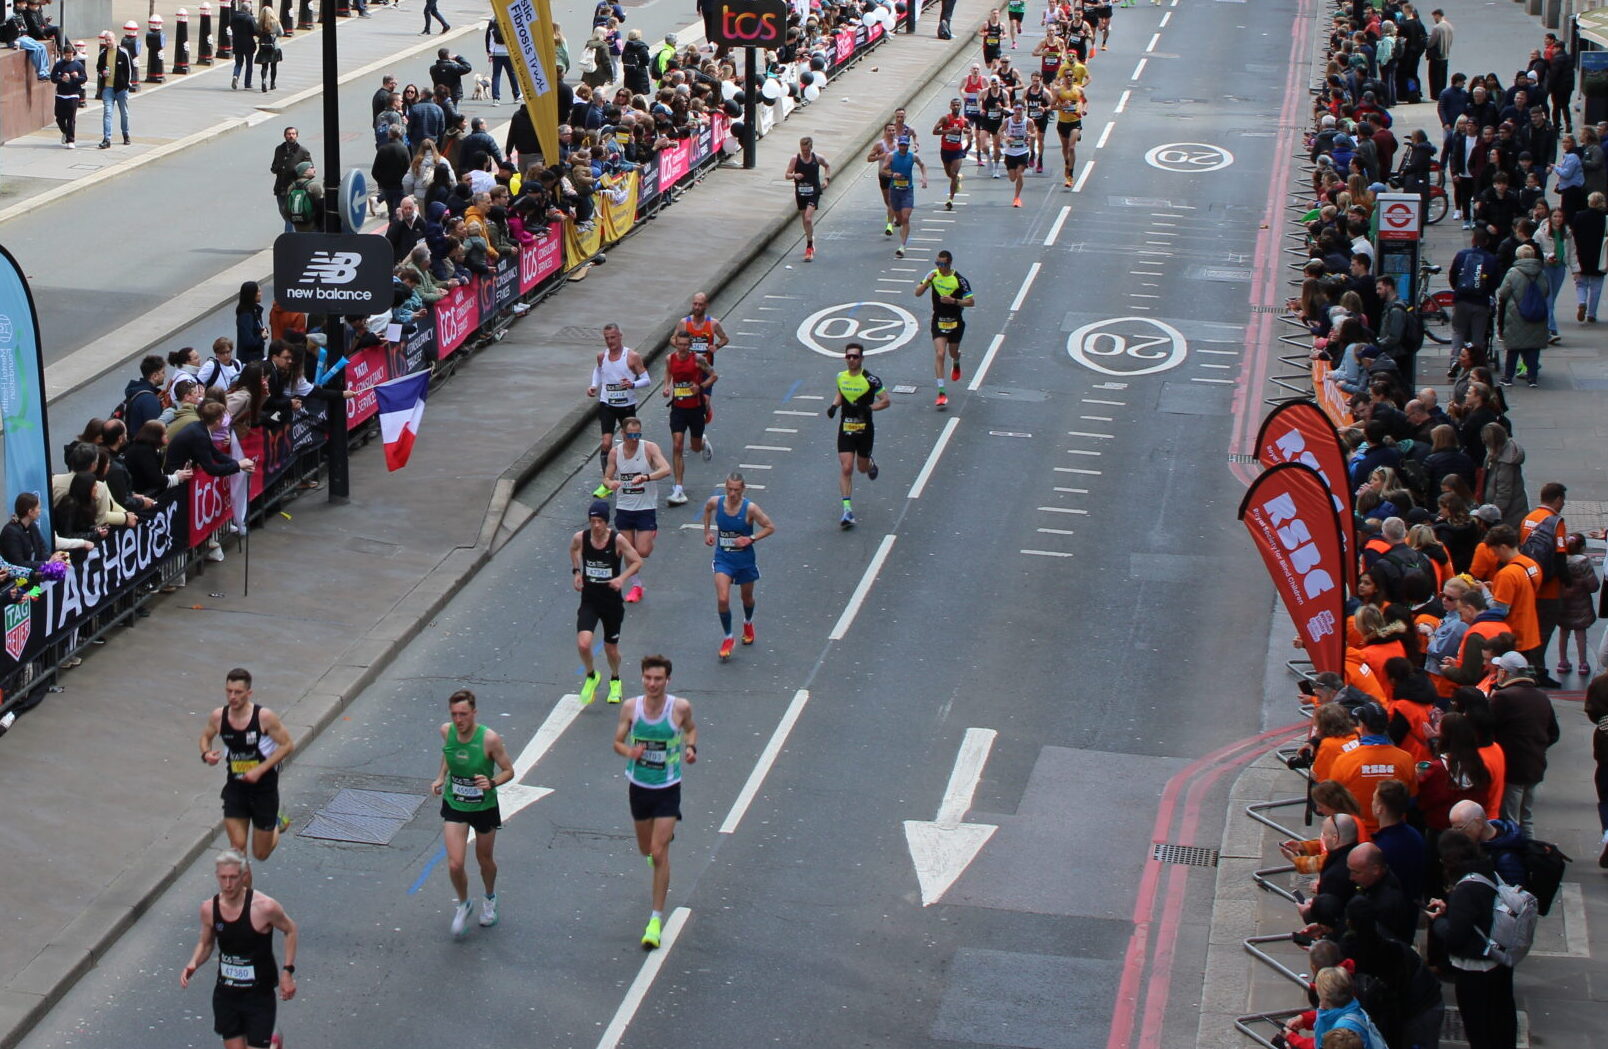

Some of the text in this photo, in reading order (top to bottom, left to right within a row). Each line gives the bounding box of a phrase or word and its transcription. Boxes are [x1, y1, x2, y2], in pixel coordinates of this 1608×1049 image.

[722, 5, 777, 41] tcs
[511, 4, 545, 91] Fibrosis Trust
[1158, 150, 1221, 165] 20
[522, 247, 538, 284] tcs
[287, 287, 372, 301] new balance
[438, 306, 458, 347] tcs
[815, 317, 903, 341] 20
[1084, 333, 1172, 359] 20
[354, 361, 368, 380] TATA
[356, 366, 384, 396] CONSULTANCY
[194, 476, 223, 530] tcs
[1252, 508, 1305, 606] Royal Society for Blind Children
[1262, 492, 1336, 600] RSBC
[7, 601, 29, 626] TAG
[7, 621, 30, 656] HEUER
